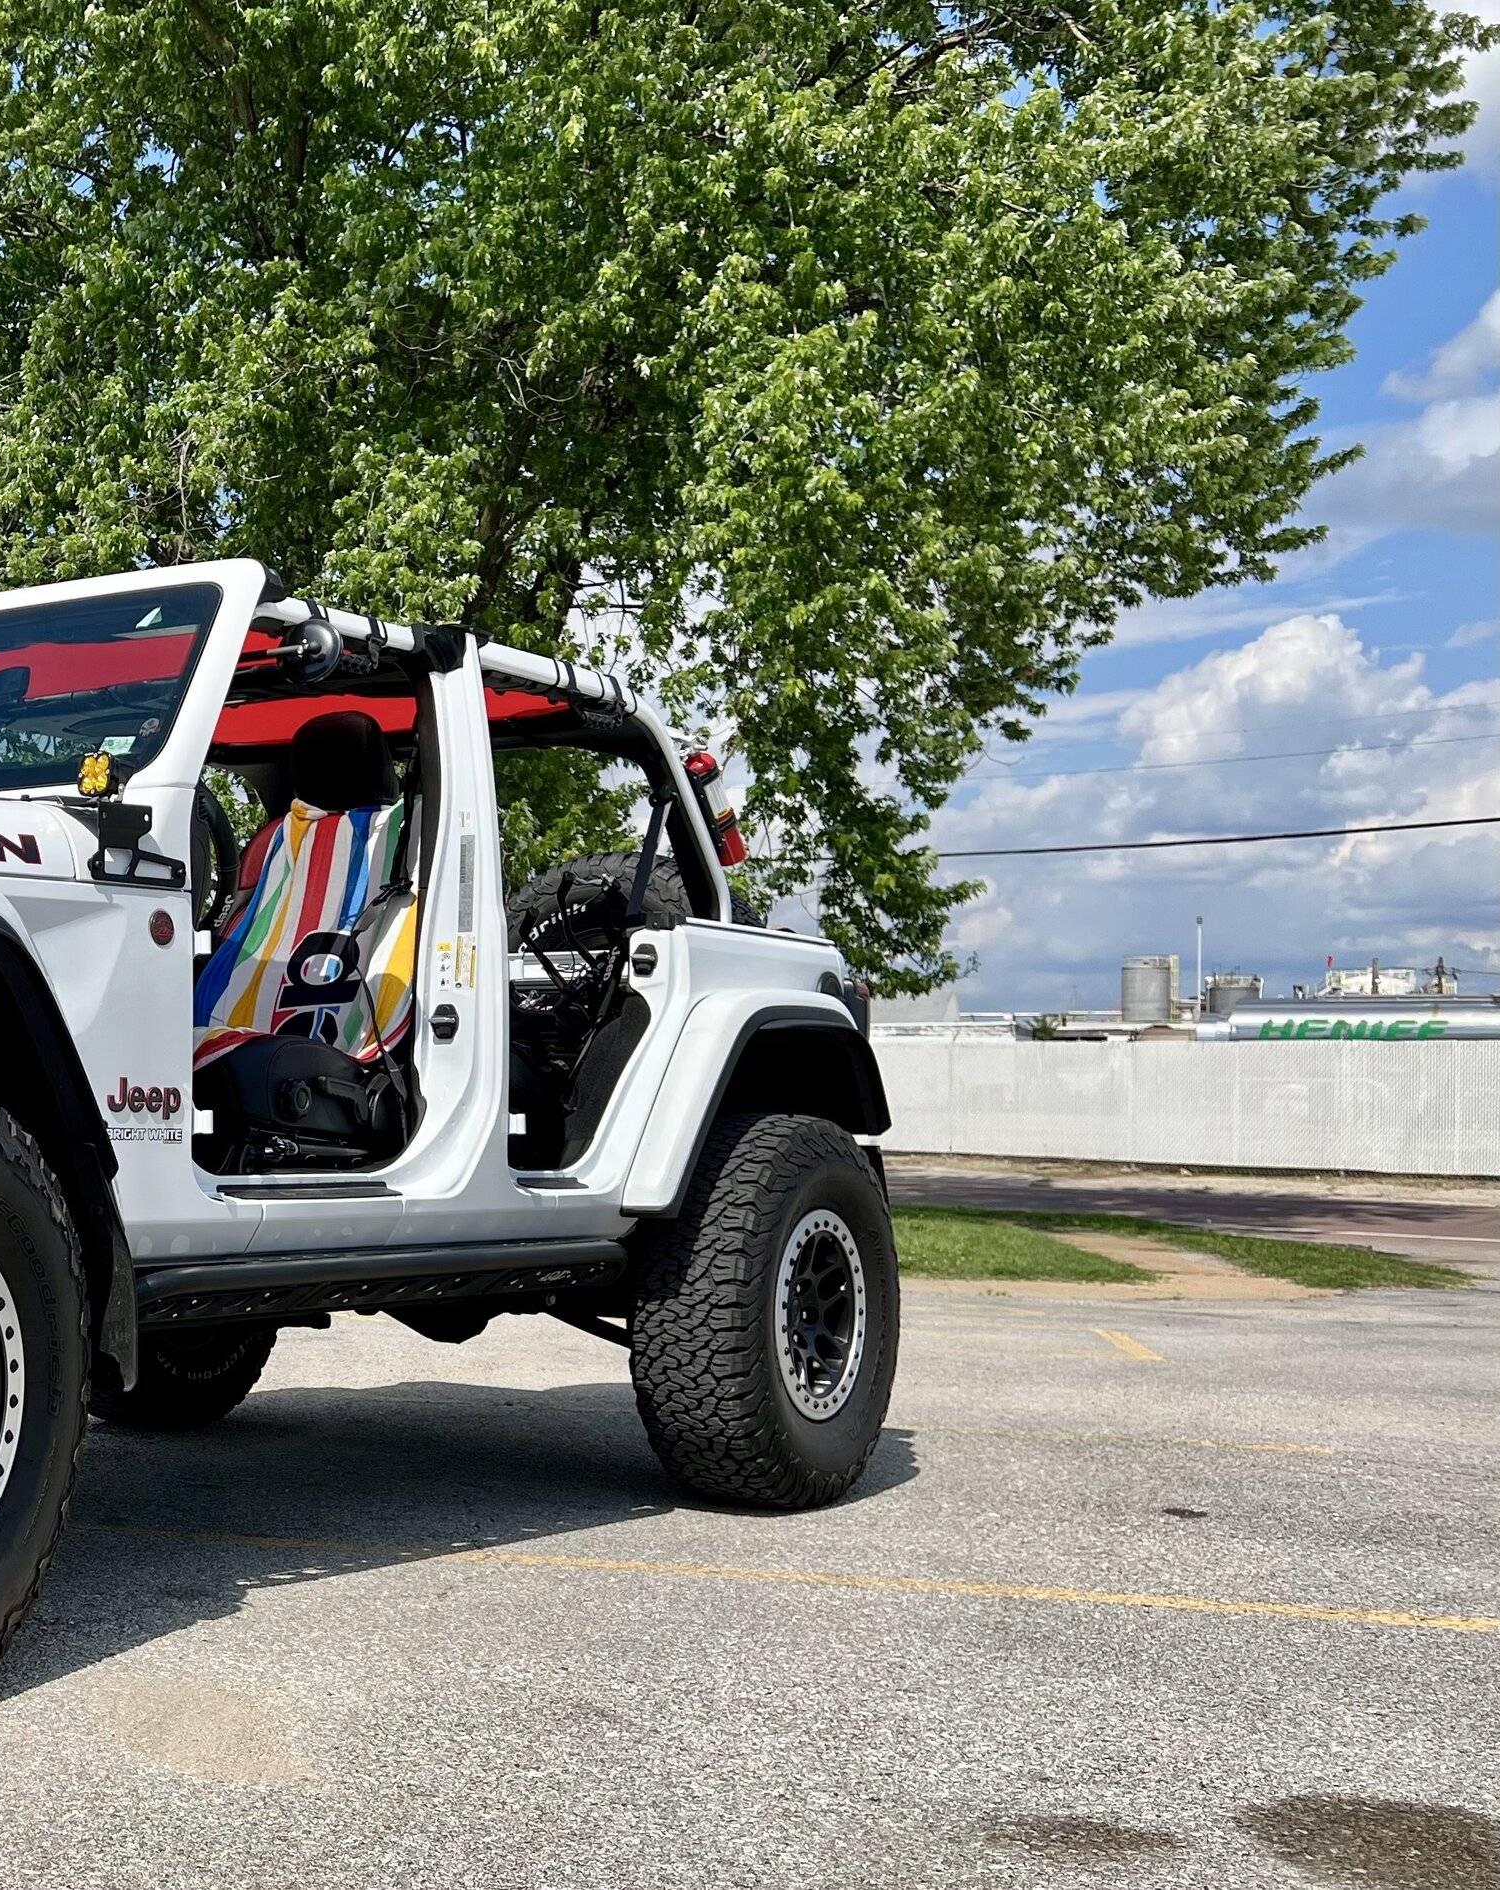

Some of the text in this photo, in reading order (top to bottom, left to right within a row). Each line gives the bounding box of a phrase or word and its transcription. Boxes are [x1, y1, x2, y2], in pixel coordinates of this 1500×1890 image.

[213, 894, 235, 928] Jeep
[106, 1076, 182, 1121] Jeep
[147, 1127, 183, 1141] WHITE
